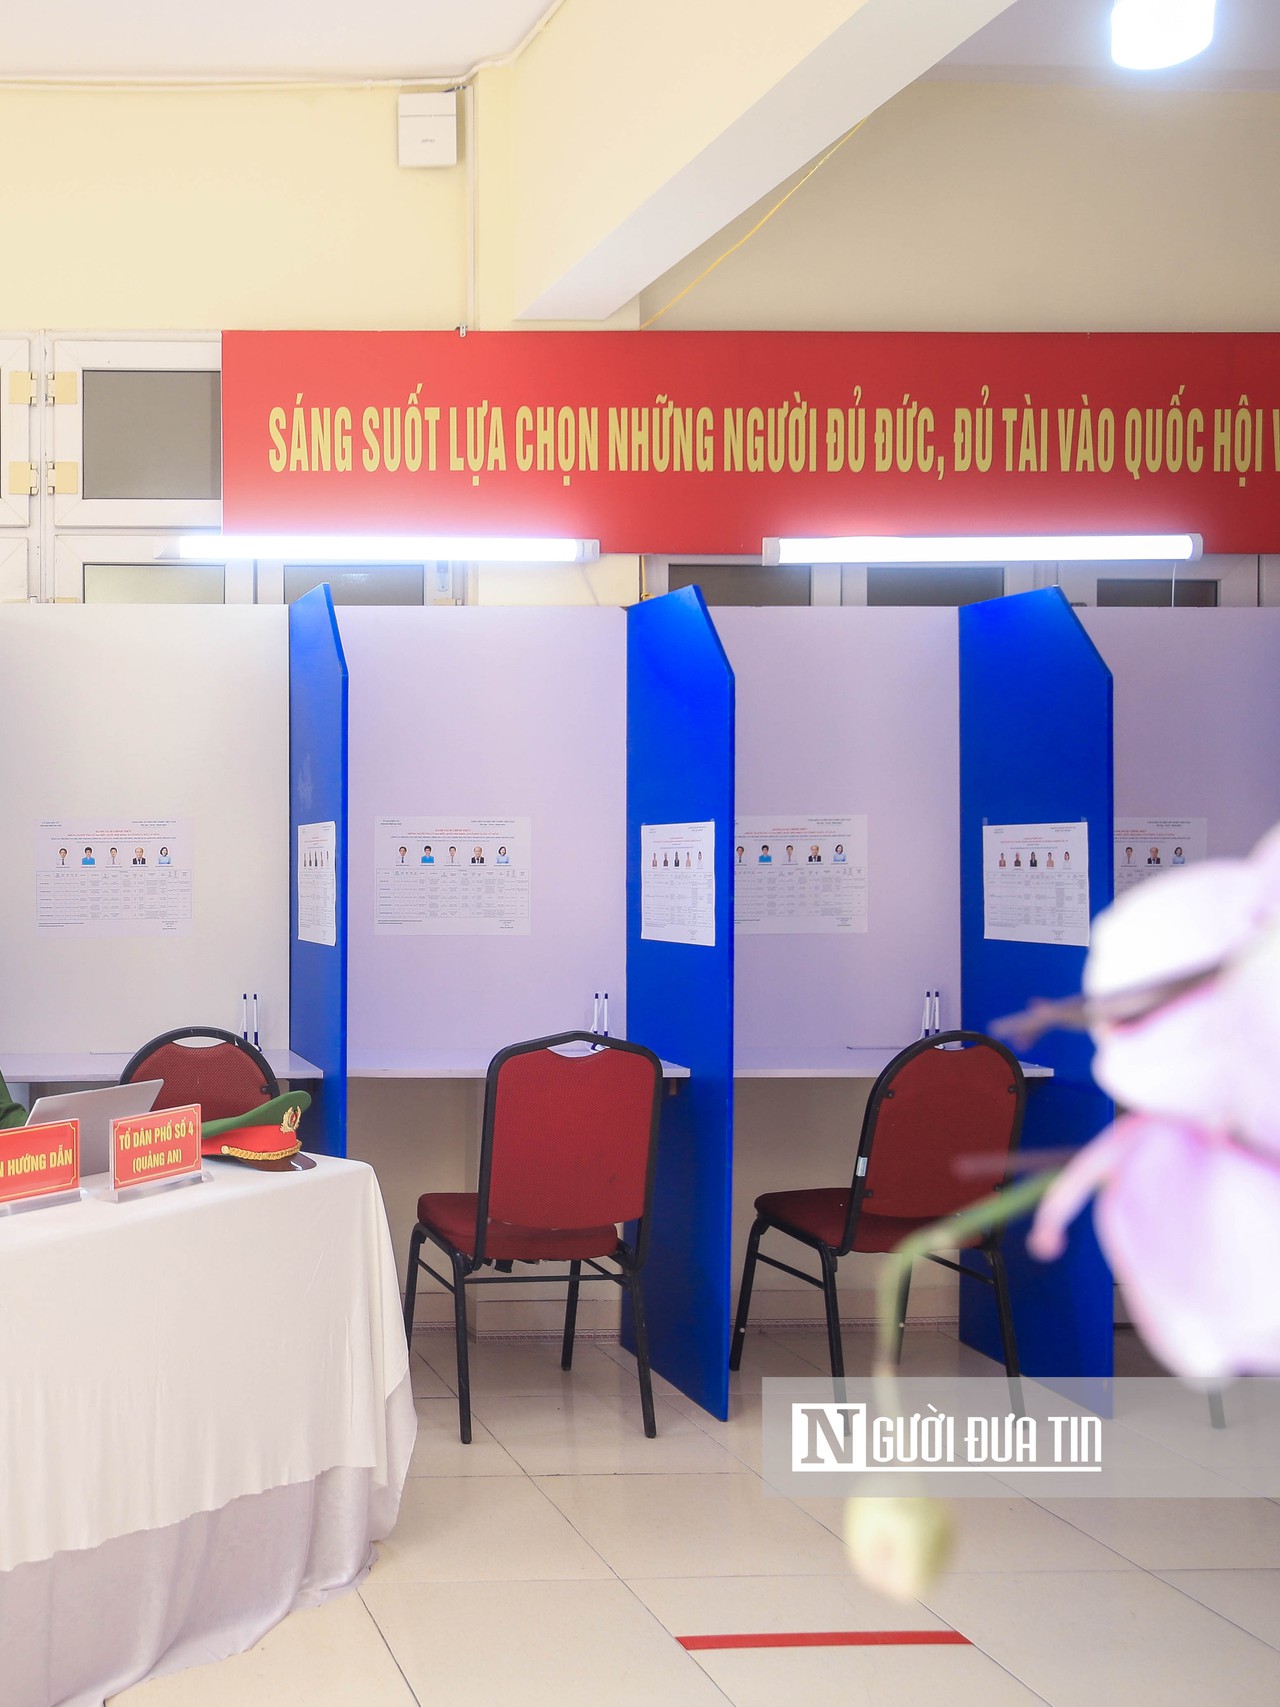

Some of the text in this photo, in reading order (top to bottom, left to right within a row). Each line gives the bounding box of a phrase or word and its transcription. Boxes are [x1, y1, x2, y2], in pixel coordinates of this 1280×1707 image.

[268, 393, 353, 473] SÁNG
[362, 383, 440, 473] SUỐT
[449, 399, 507, 486] LỰA
[516, 406, 599, 486] CHỌN
[608, 393, 714, 473] NHỮNG
[723, 391, 817, 473] NGƯỜI
[826, 385, 865, 473] ĐỦ
[874, 393, 944, 481] ĐỨC,
[953, 385, 993, 473] ĐỦ
[1002, 394, 1048, 473] TÀI
[1058, 394, 1115, 473] VÀO
[1124, 385, 1204, 481] QUỐC
[1213, 394, 1263, 487] HỘI
[118, 1116, 194, 1151] TỔ DÂN PHỐ SỐ 4
[7, 1153, 47, 1177] HƯỚNG
[49, 1144, 73, 1169] DẪN
[133, 1148, 182, 1173] (QUẢNG AN)
